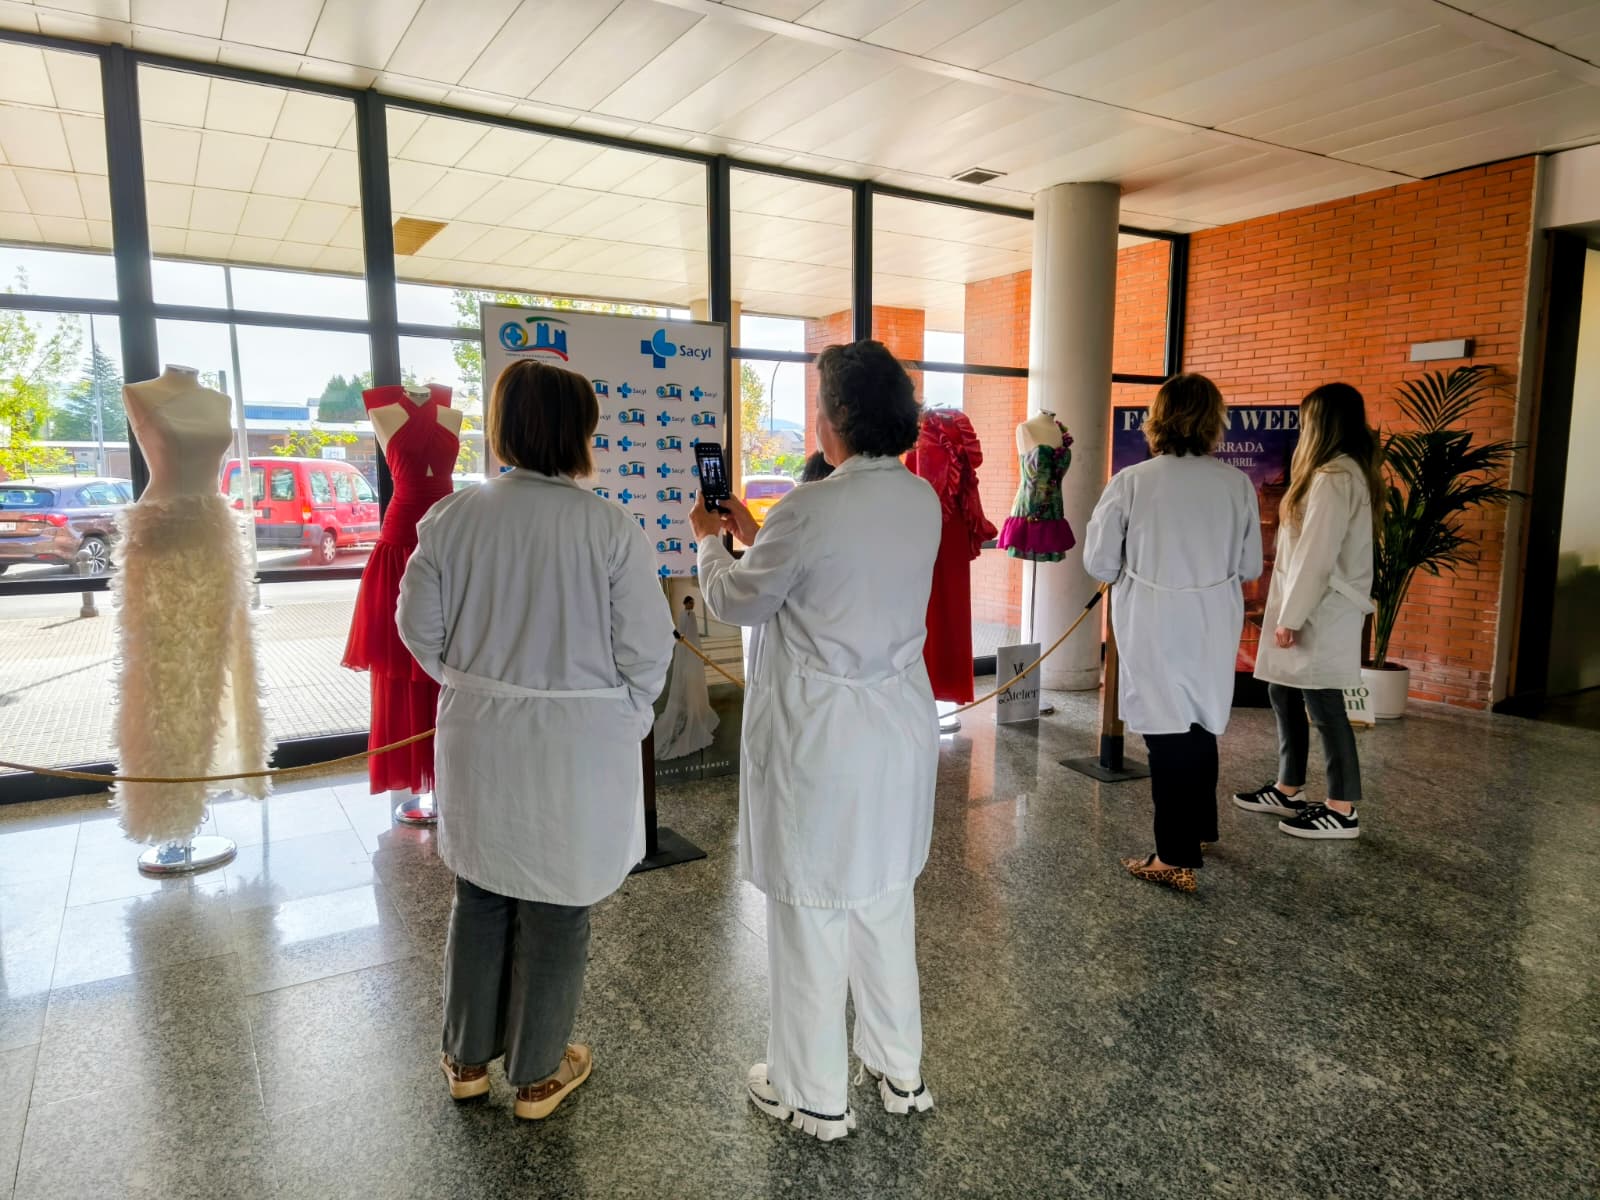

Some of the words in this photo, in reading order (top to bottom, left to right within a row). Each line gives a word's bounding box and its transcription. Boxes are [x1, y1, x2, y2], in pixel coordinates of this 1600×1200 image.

[680, 344, 712, 361] Sacyl
[1239, 410, 1299, 430] WEE
[1215, 441, 1264, 453] RRADA
